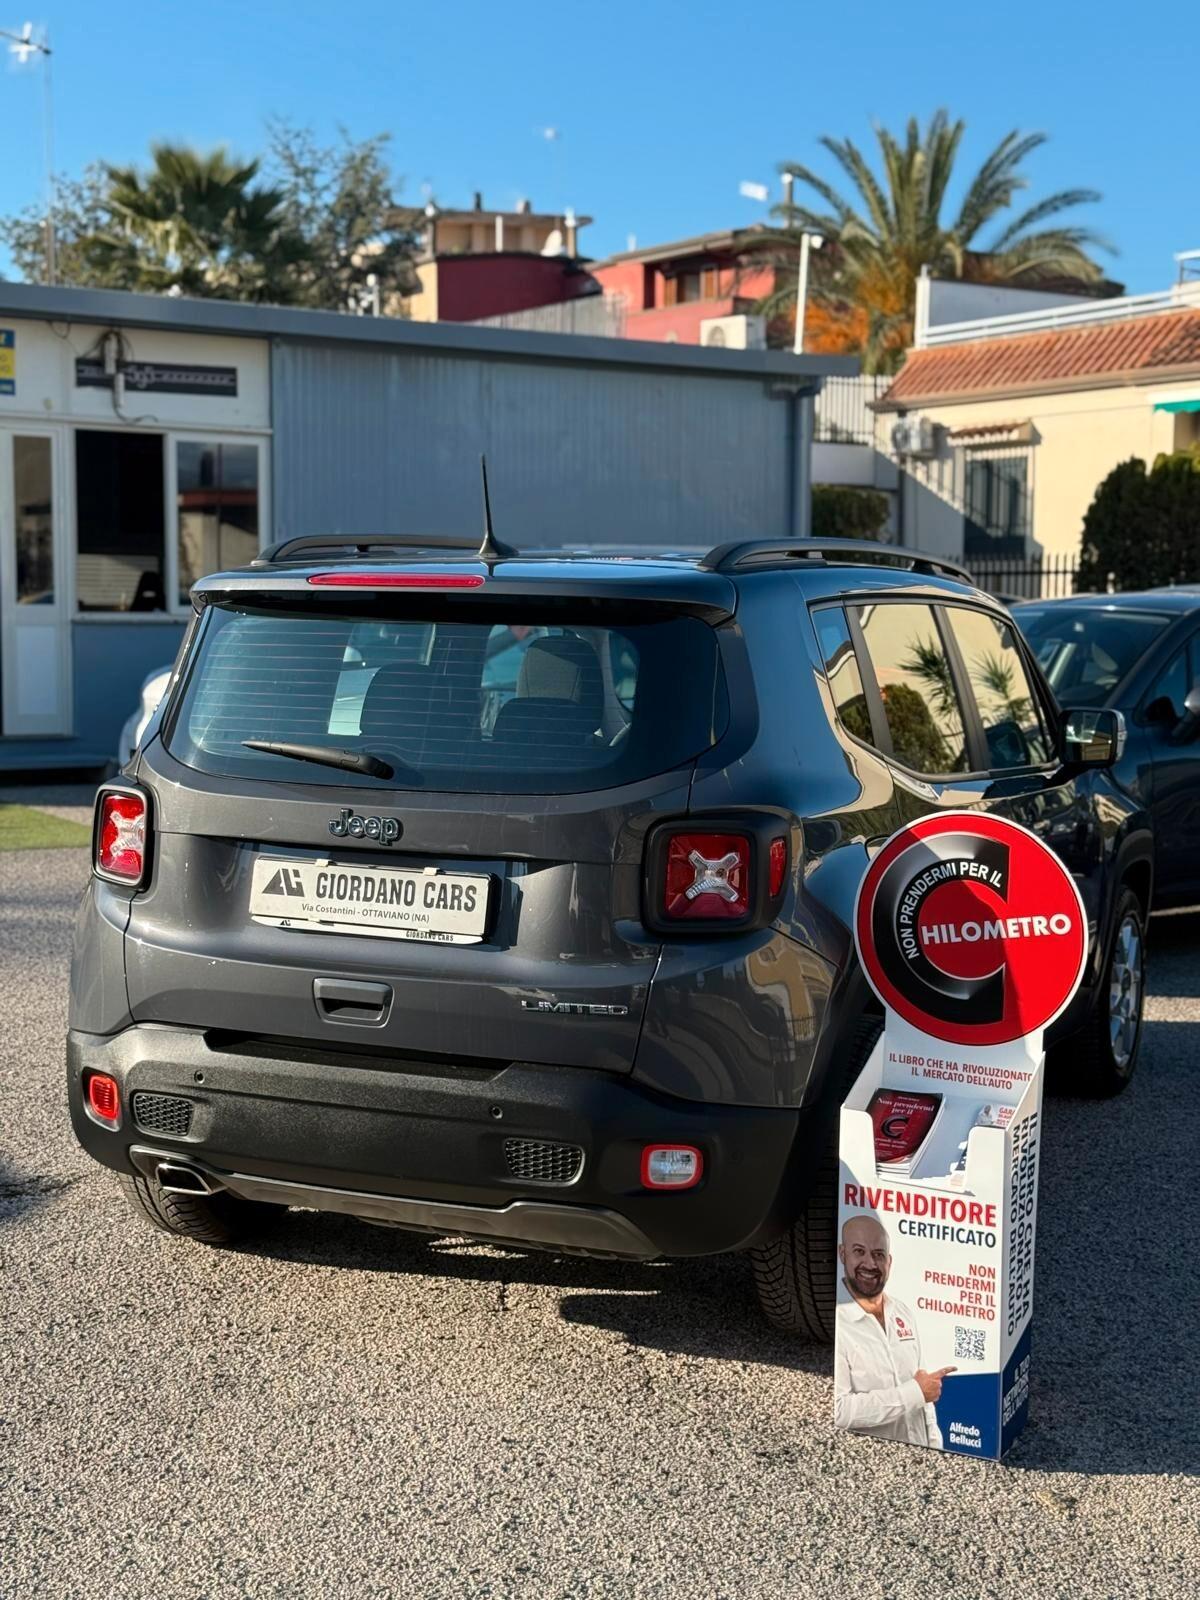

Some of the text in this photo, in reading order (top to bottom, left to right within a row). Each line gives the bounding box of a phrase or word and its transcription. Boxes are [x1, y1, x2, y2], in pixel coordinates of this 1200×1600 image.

[329, 808, 402, 846] Jeep
[316, 872, 477, 912] GIORDANO CARS
[302, 903, 314, 913] Via
[315, 905, 356, 916] Costantini
[361, 908, 410, 921] OTTAVIANO
[411, 913, 430, 924] (NA)
[900, 861, 1002, 960] NON PRENDERMI PER IL
[521, 1000, 628, 1015] LIMITED
[889, 1053, 897, 1063] IL
[898, 1054, 925, 1067] LIBRO
[926, 1058, 944, 1070] CHE
[946, 1060, 959, 1071] HA
[911, 1066, 1012, 1090] IL MERCATO DELL'AUTO
[1010, 1124, 1021, 1224] MERCATO
[844, 1183, 997, 1228] RIVENDITORE
[1015, 1116, 1029, 1301] RIVOLUZIONATO
[1022, 1112, 1038, 1318] IL LIBRO CHE HA
[898, 1219, 997, 1248] CERTIFICATO
[924, 1270, 996, 1293] PRENDERMI
[968, 1263, 996, 1279] NON
[917, 1296, 995, 1321] CHILOMETRO
[959, 1290, 996, 1308] PER IL
[949, 1421, 981, 1437] Alfredo
[949, 1433, 982, 1448] Bellucci
